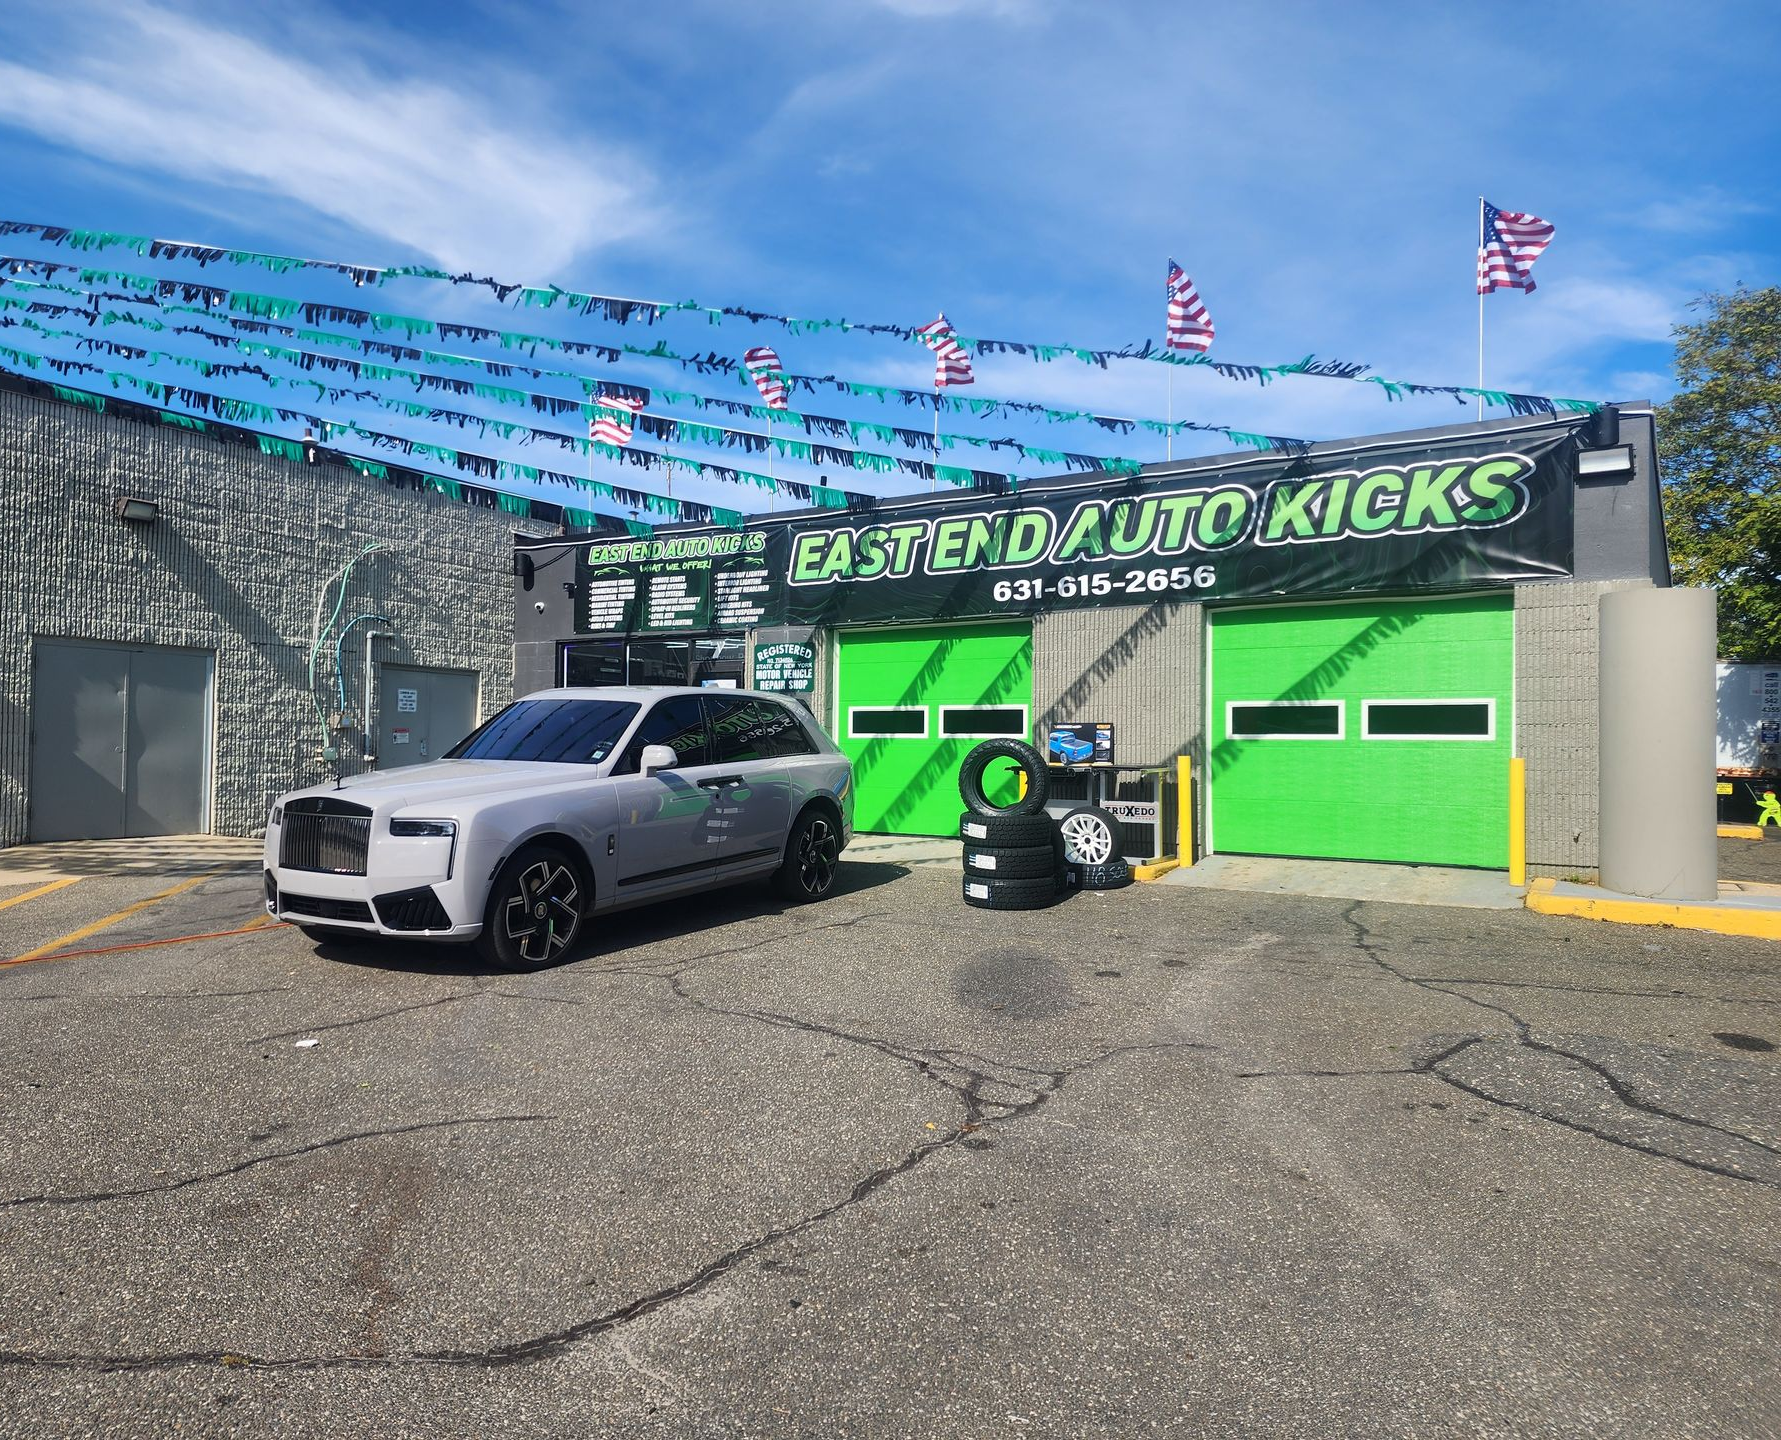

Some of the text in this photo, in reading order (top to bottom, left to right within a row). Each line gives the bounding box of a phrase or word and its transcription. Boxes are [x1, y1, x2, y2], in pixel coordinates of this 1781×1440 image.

[788, 454, 1535, 586] EAST END AUTO KICKS
[588, 531, 766, 565] EAST END AUTO KICKS
[640, 563, 664, 572] WHAT
[682, 559, 712, 570] OFFER!
[746, 570, 768, 578] LIGHTING
[993, 565, 1217, 602] 631-615-2656
[757, 644, 812, 661] REGISTERED
[756, 669, 812, 680] MOTOR VEHICLE
[760, 680, 808, 690] REPAIR SHOP
